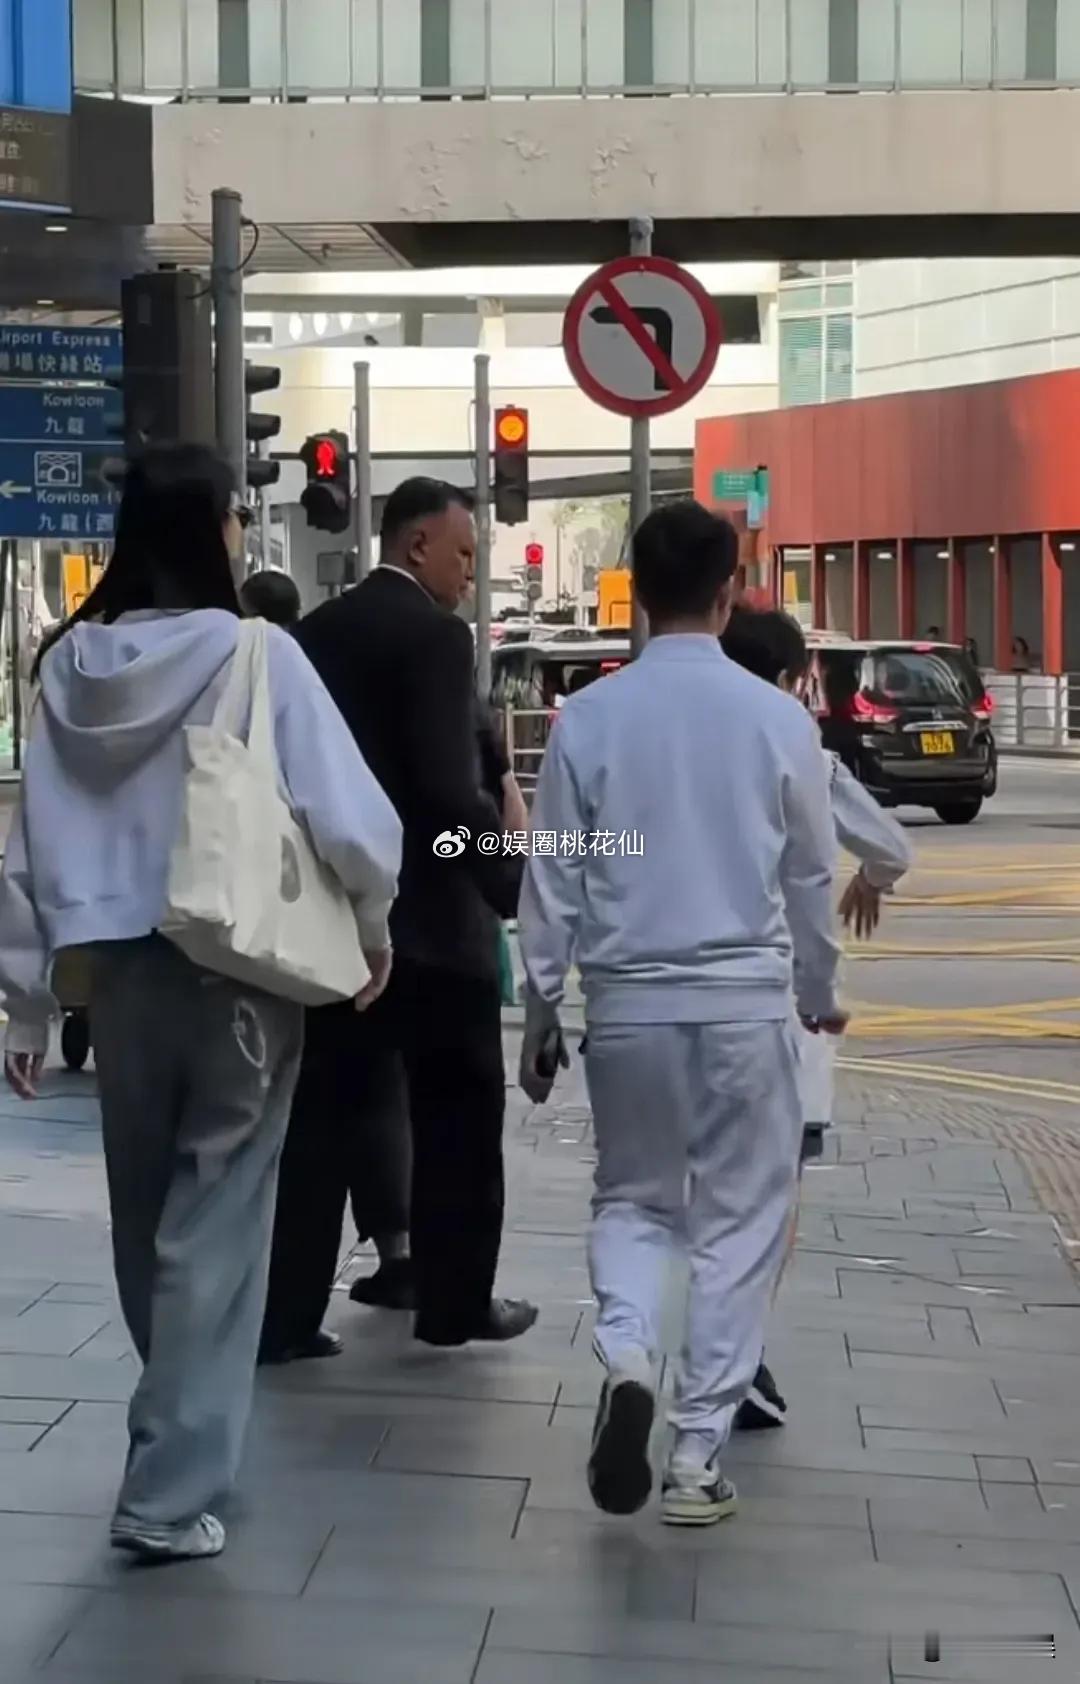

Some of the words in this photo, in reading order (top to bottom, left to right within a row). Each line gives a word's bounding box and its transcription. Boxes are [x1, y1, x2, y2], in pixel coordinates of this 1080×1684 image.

[52, 330, 110, 347] Express
[43, 393, 104, 408] Kowloon
[36, 489, 99, 504] Kowloon
